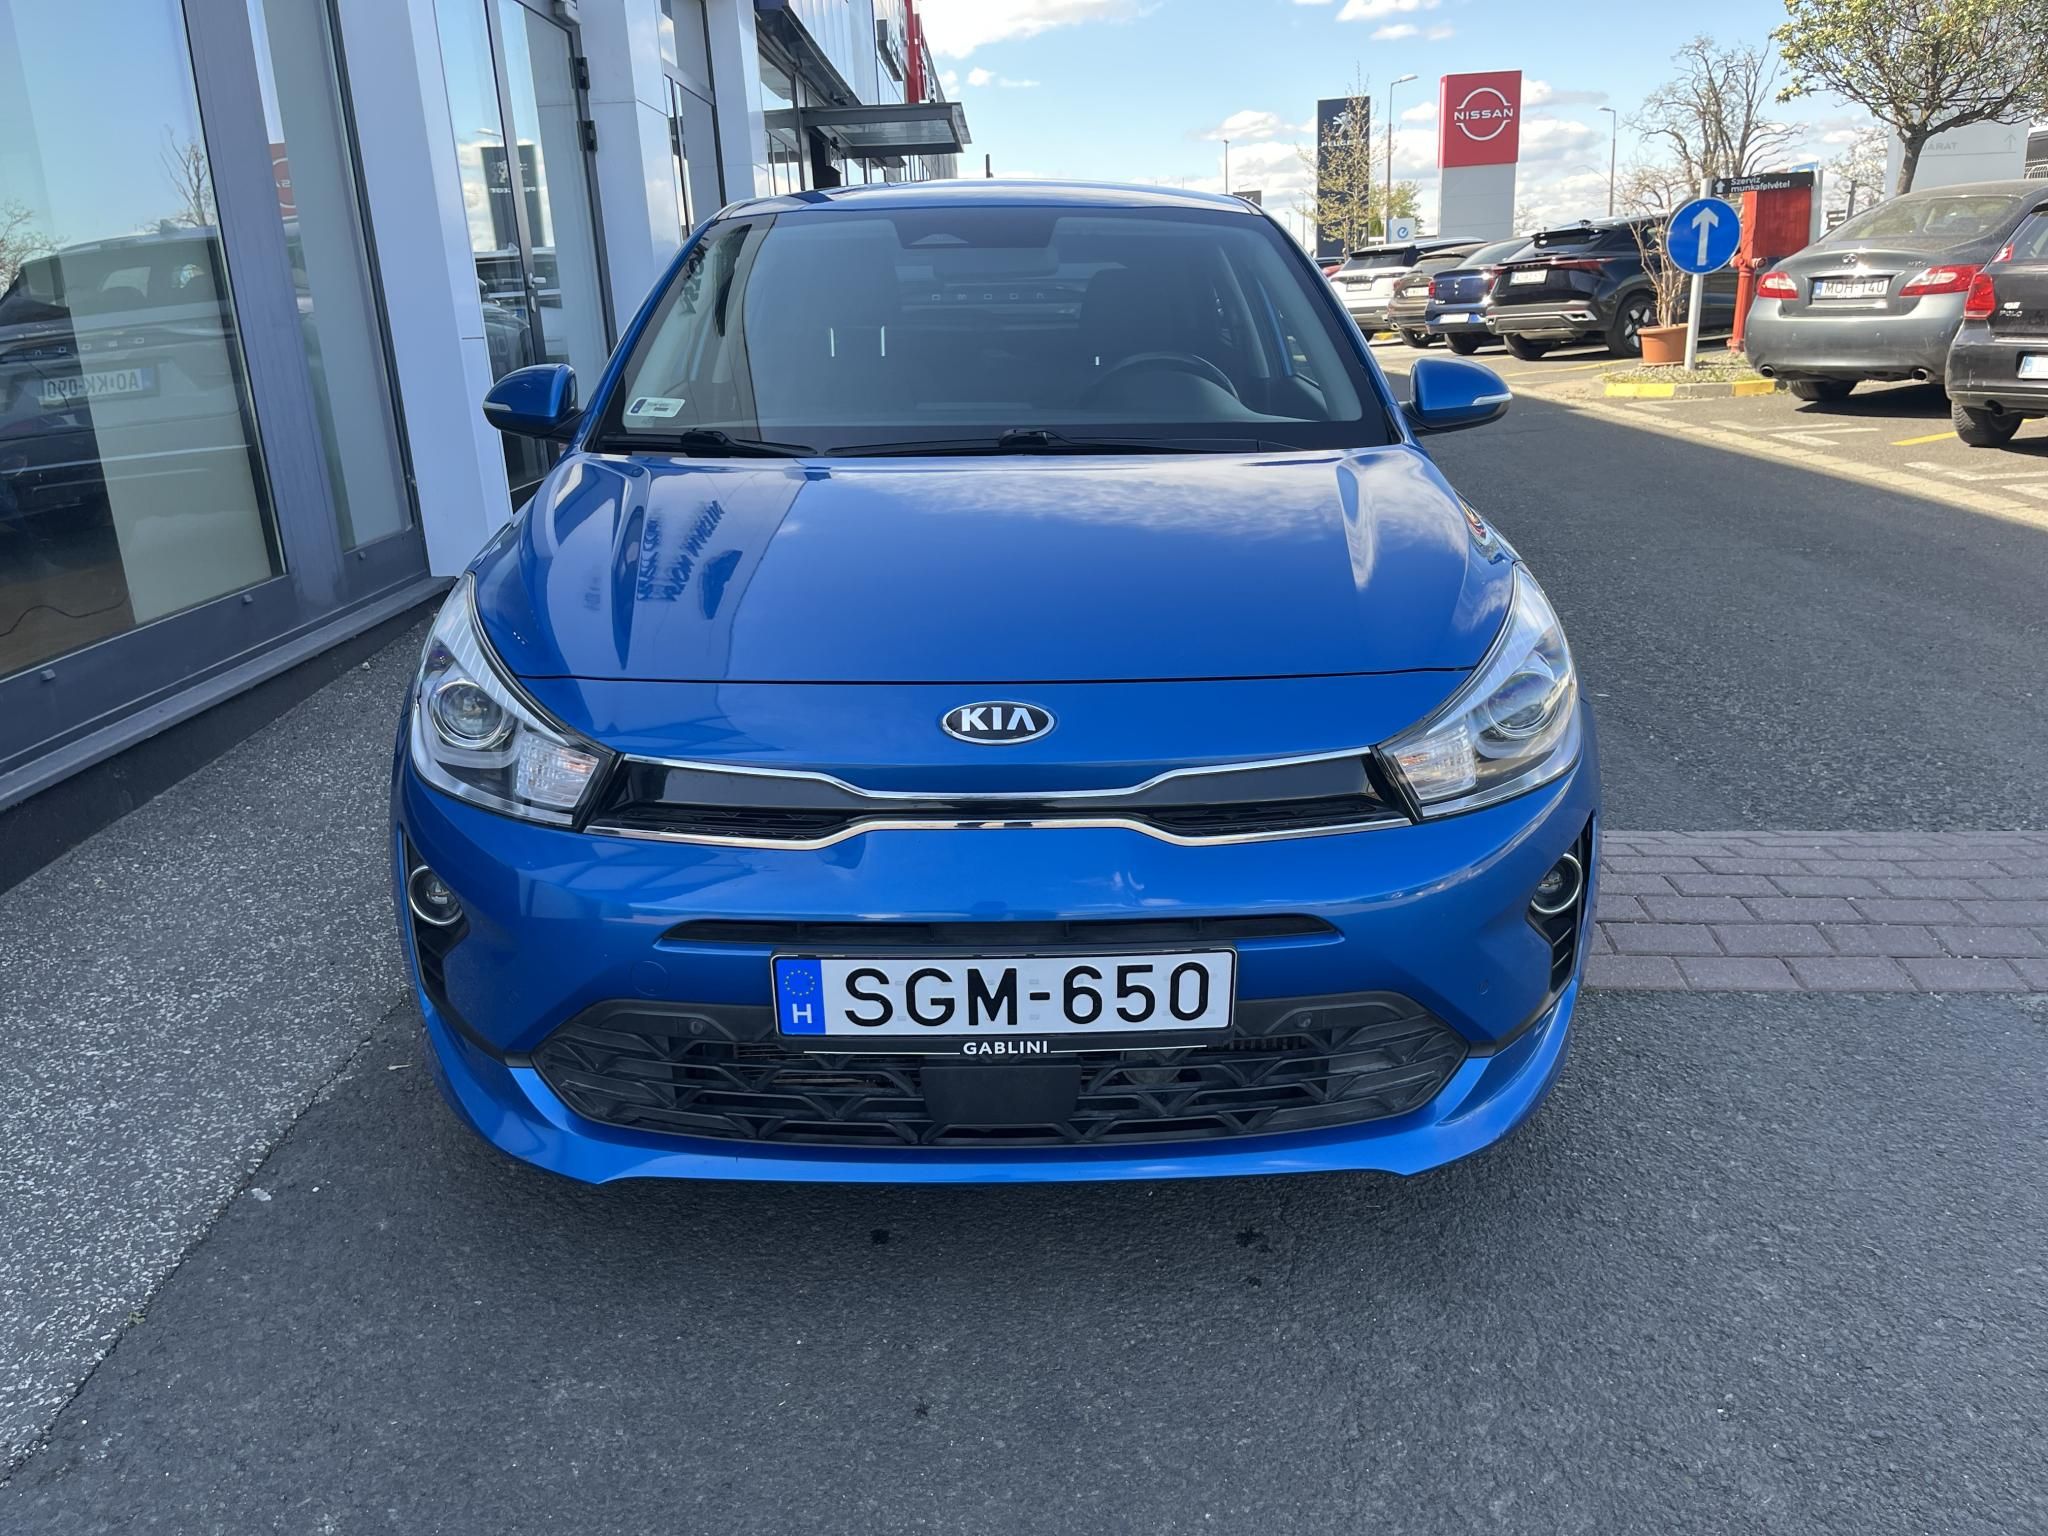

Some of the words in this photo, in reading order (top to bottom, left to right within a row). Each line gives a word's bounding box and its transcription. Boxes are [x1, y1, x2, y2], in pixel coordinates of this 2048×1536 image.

[1454, 108, 1513, 121] NISSAN
[1731, 176, 1761, 186] Szerviz
[1824, 280, 1885, 294] MOH-140
[960, 706, 1036, 732] KIA
[792, 1003, 813, 1024] H
[844, 962, 1210, 1028] SGM-650
[963, 1040, 1050, 1056] GABLINI
